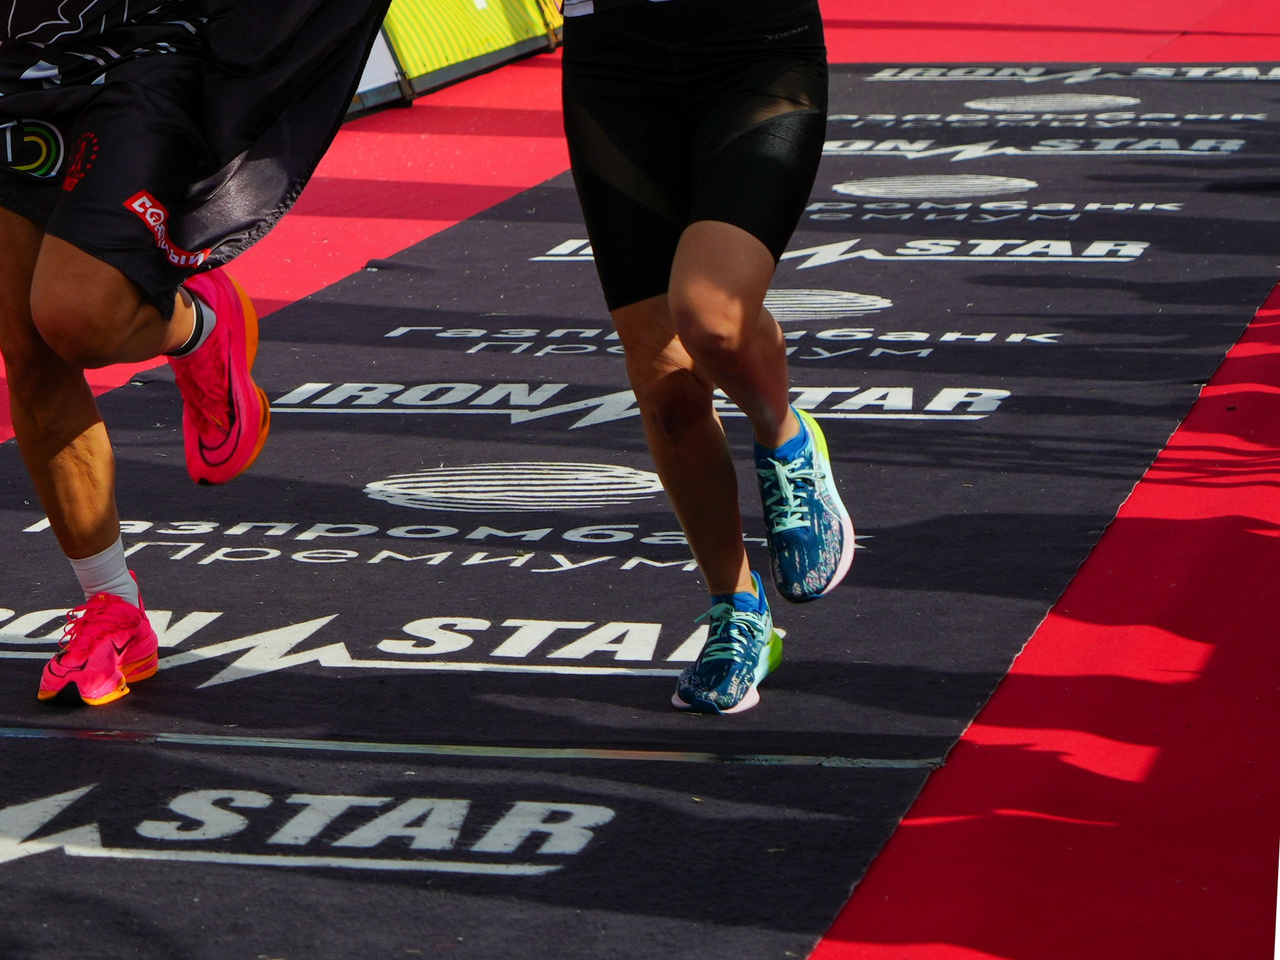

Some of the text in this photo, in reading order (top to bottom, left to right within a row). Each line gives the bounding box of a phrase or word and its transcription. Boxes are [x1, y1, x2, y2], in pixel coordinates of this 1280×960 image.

[823, 138, 1247, 151] ON STAR
[805, 200, 1186, 211] ромбанк
[809, 213, 1081, 223] емиум
[895, 239, 1152, 256] STAR
[271, 382, 569, 406] IRON
[125, 542, 699, 573] Премиум
[134, 788, 617, 856] STAR
